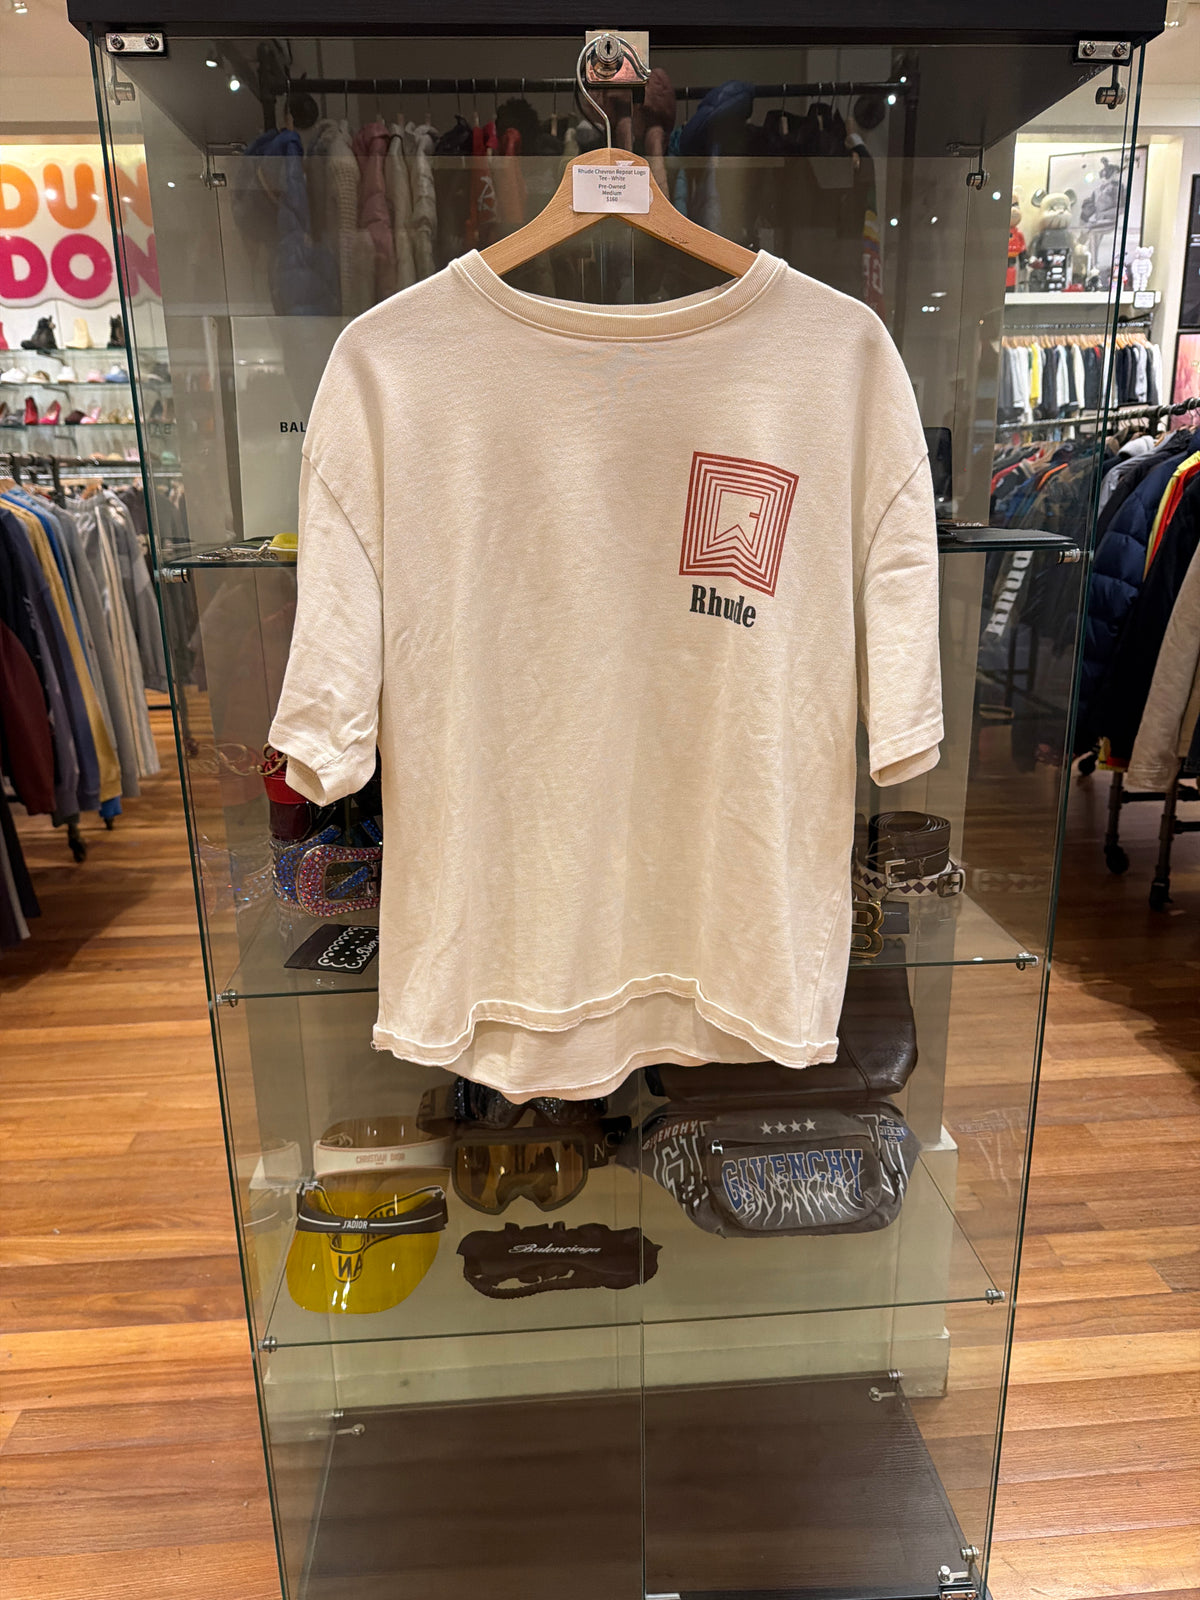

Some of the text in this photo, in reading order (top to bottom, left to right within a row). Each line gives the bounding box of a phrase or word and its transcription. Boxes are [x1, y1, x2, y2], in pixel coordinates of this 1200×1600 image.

[280, 421, 307, 433] BAL
[689, 584, 757, 628] Rhude
[721, 1148, 864, 1213] GIVENCHY
[508, 1243, 602, 1255] Balenciaga
